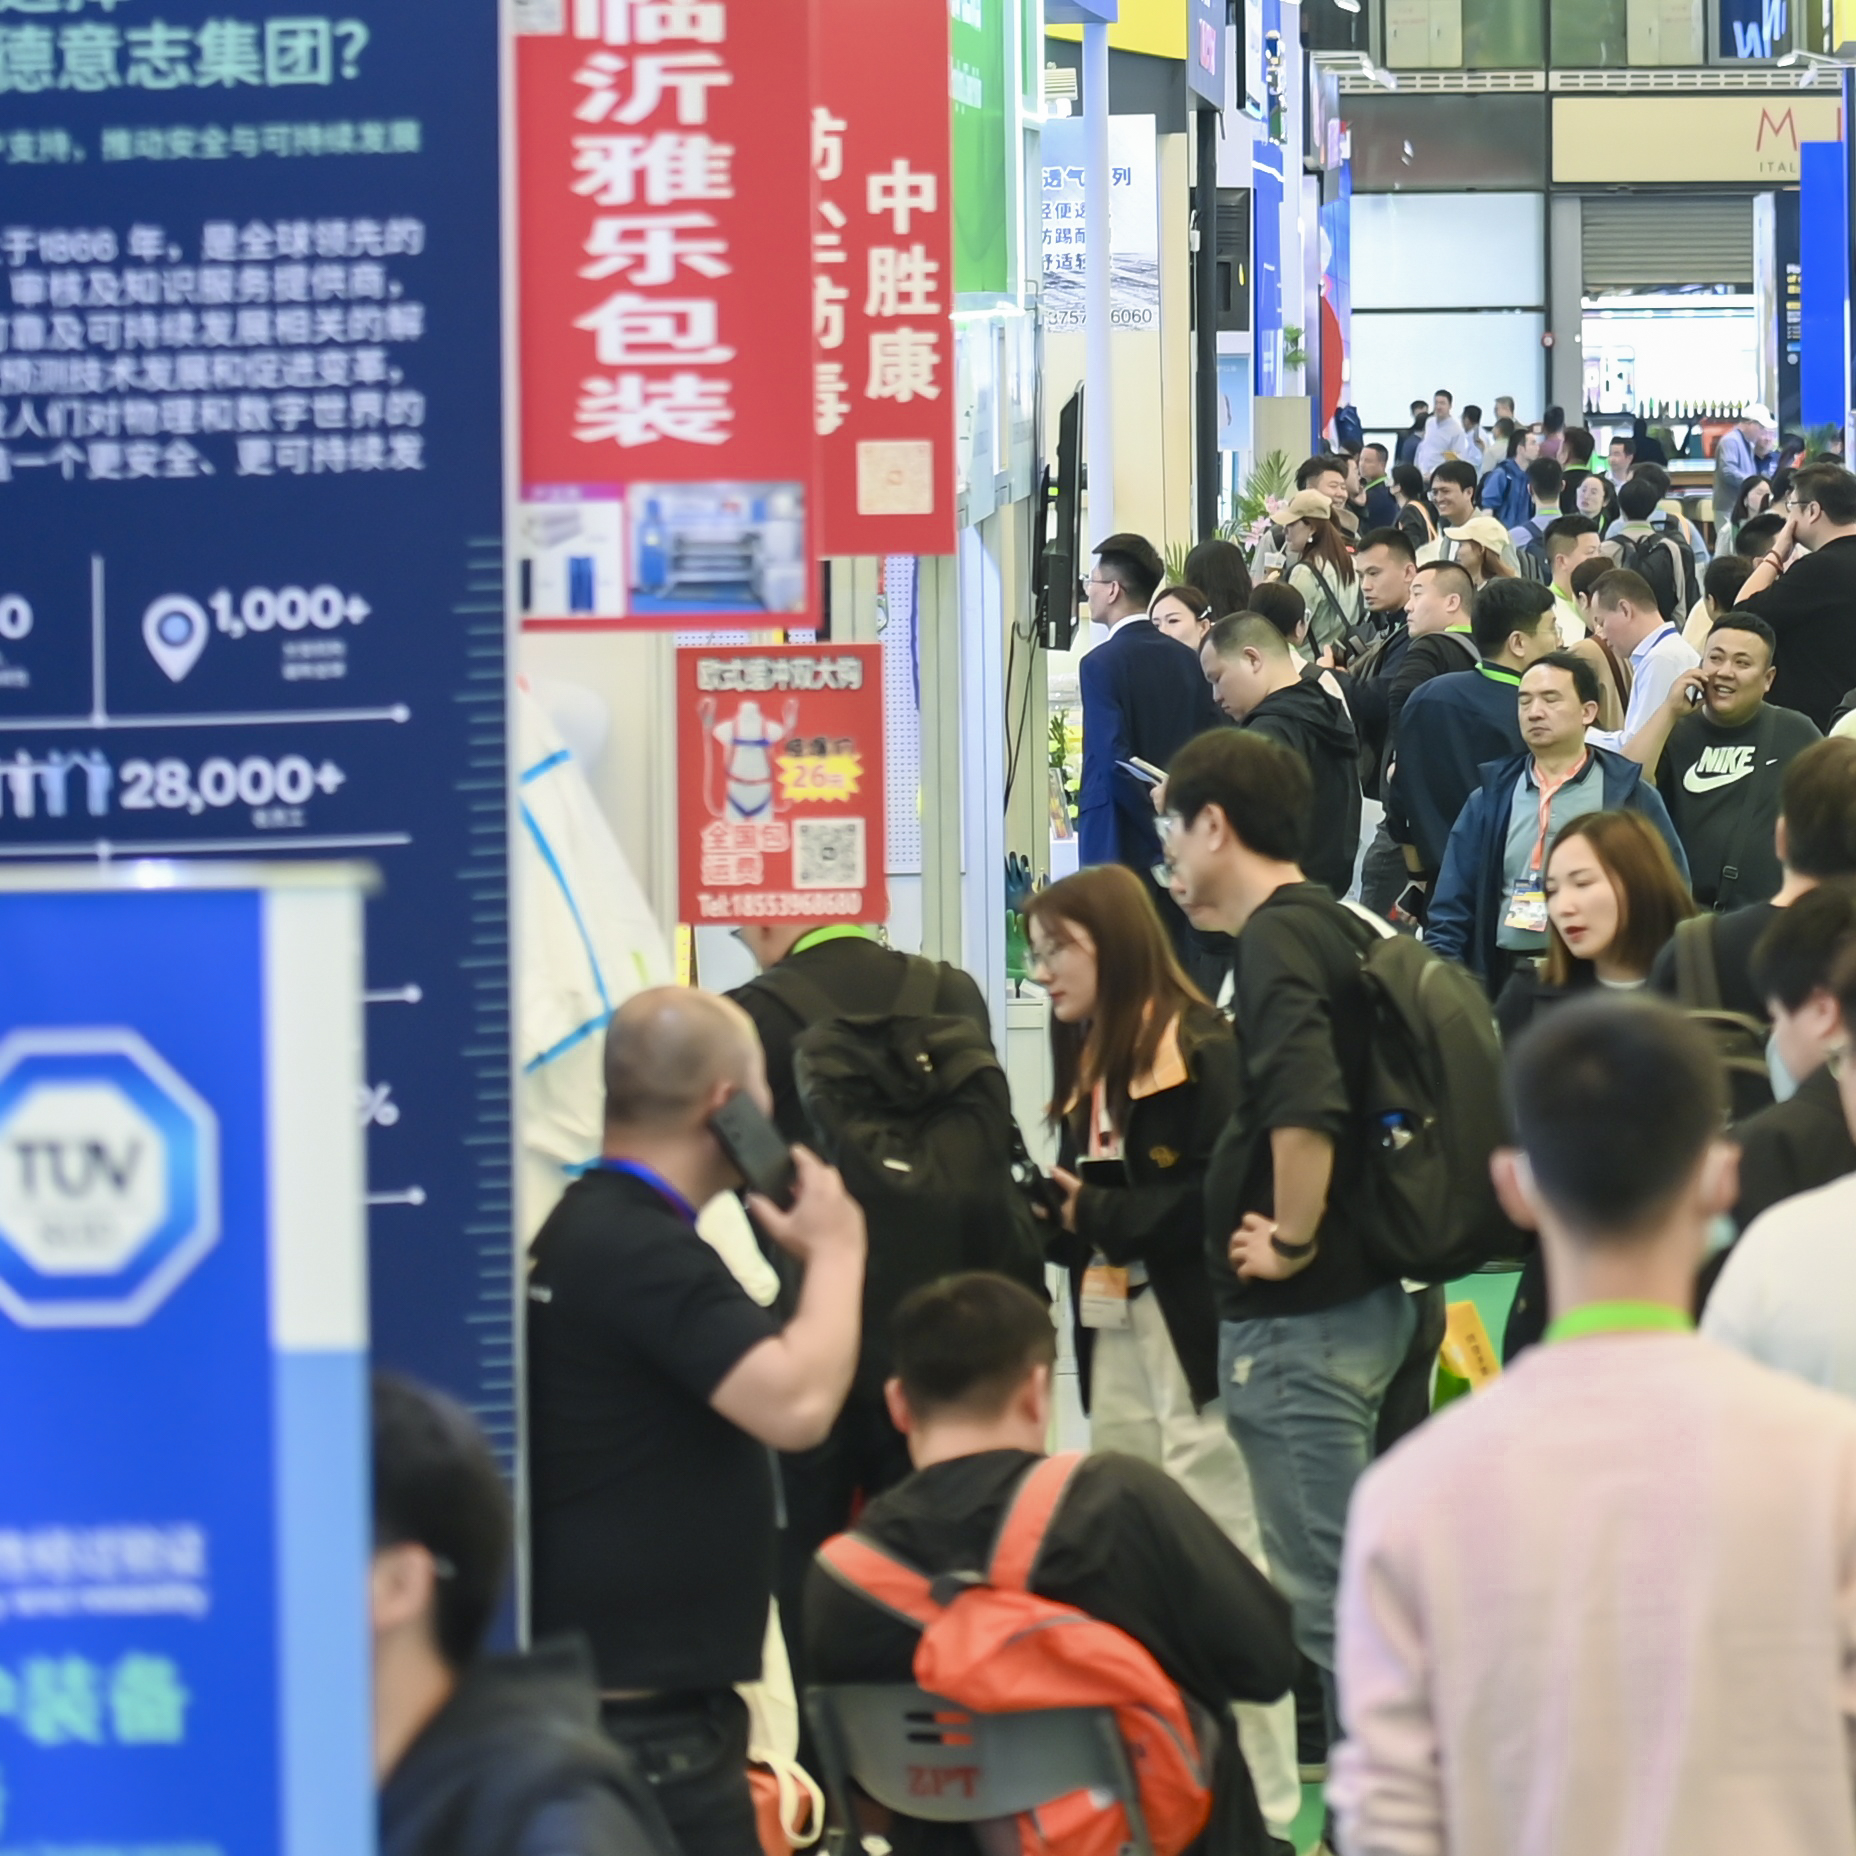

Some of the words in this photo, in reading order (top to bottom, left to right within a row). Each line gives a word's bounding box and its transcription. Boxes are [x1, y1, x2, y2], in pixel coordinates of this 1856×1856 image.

[864, 159, 942, 402] 中胜康
[209, 585, 371, 638] 1,000+
[120, 756, 345, 814] 28,000+
[1698, 746, 1756, 775] NIKE
